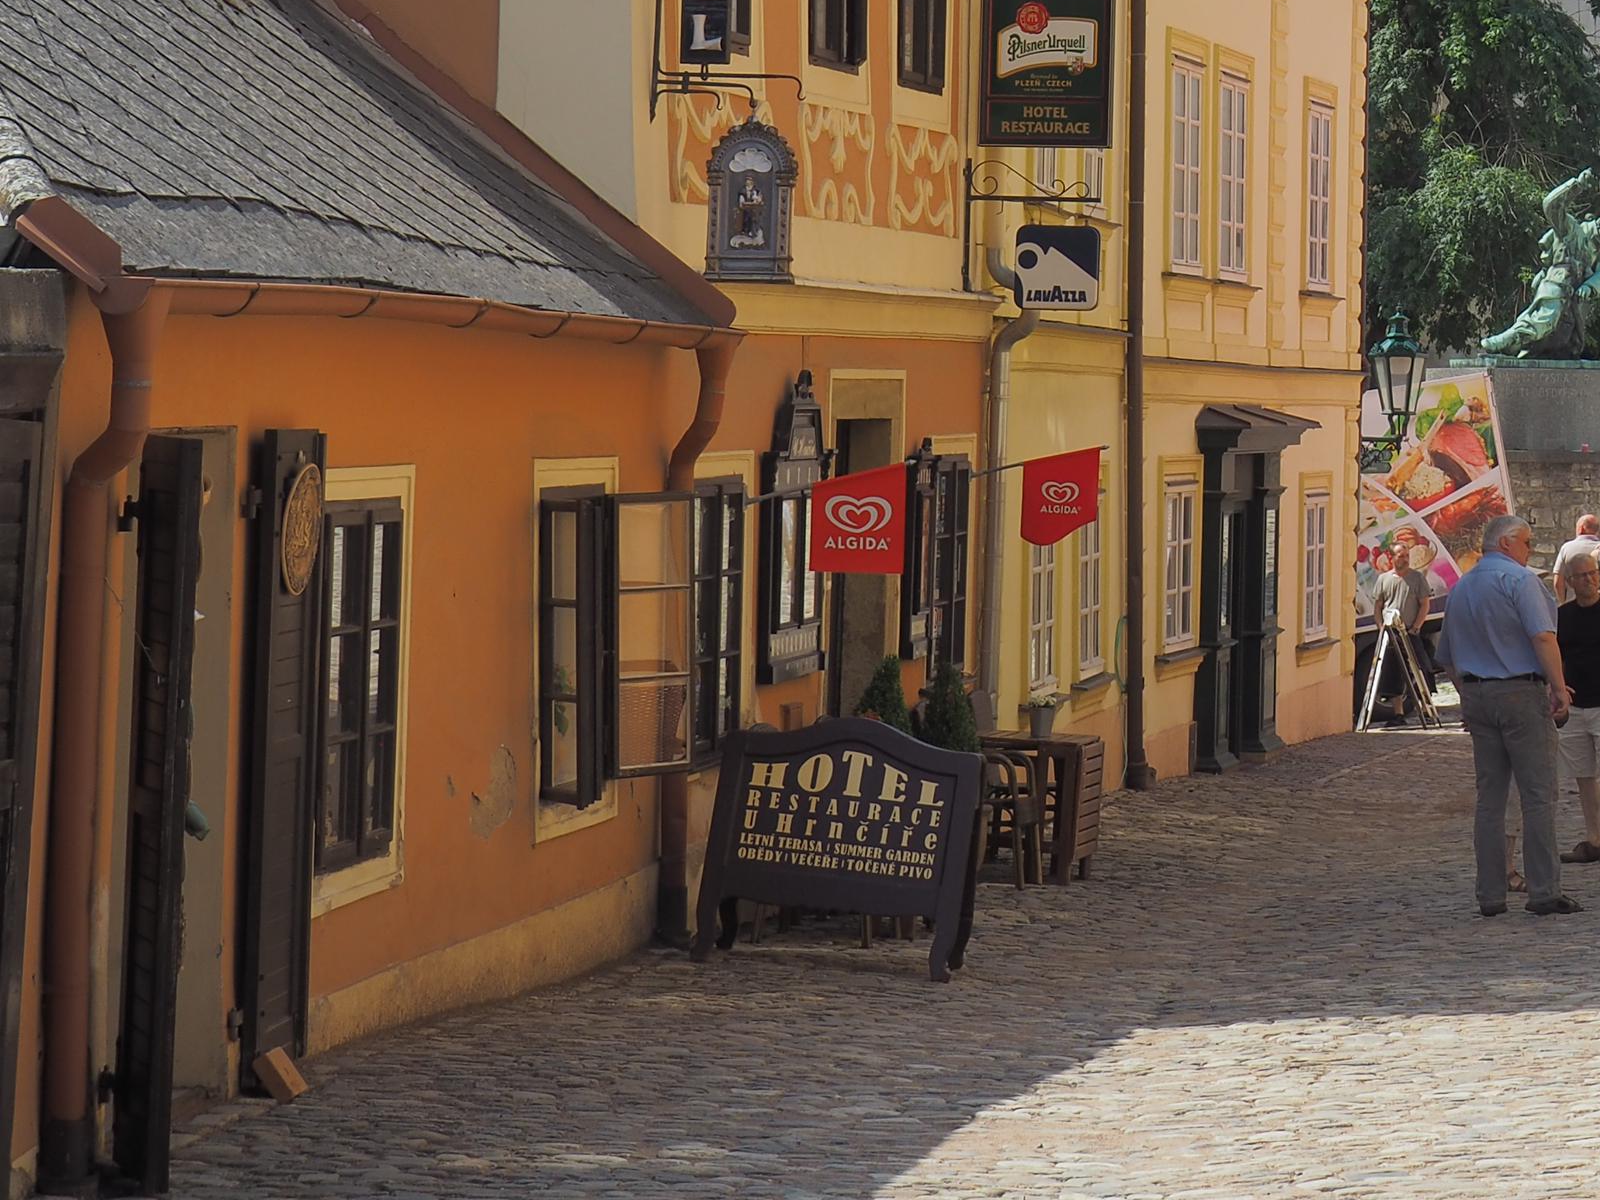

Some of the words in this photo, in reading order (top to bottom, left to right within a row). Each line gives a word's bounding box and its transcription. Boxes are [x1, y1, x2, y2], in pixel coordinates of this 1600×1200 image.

[1007, 33, 1048, 62] Pilsner
[1047, 33, 1086, 54] Urquell
[1046, 79, 1072, 88] CZECH
[1023, 106, 1068, 119] HOTEL
[1001, 121, 1091, 134] RESTAURACE
[1026, 285, 1087, 302] LAVAZZA
[1040, 505, 1079, 515] ALGIDA
[824, 536, 889, 551] ALGIDA
[749, 750, 945, 807] HOTEL
[746, 789, 942, 828] RESTAURACE
[743, 809, 759, 829] U
[776, 813, 939, 850] Hrnčíře
[739, 831, 775, 847] LETNÍ
[778, 836, 823, 853] TERASA
[833, 842, 883, 860] SUMMER
[886, 849, 935, 866] GARDEN
[737, 846, 783, 863] OBĚDY
[791, 852, 839, 869] VEČEŘE
[846, 858, 896, 876] TOČENÉ
[899, 864, 933, 880] PIVO
